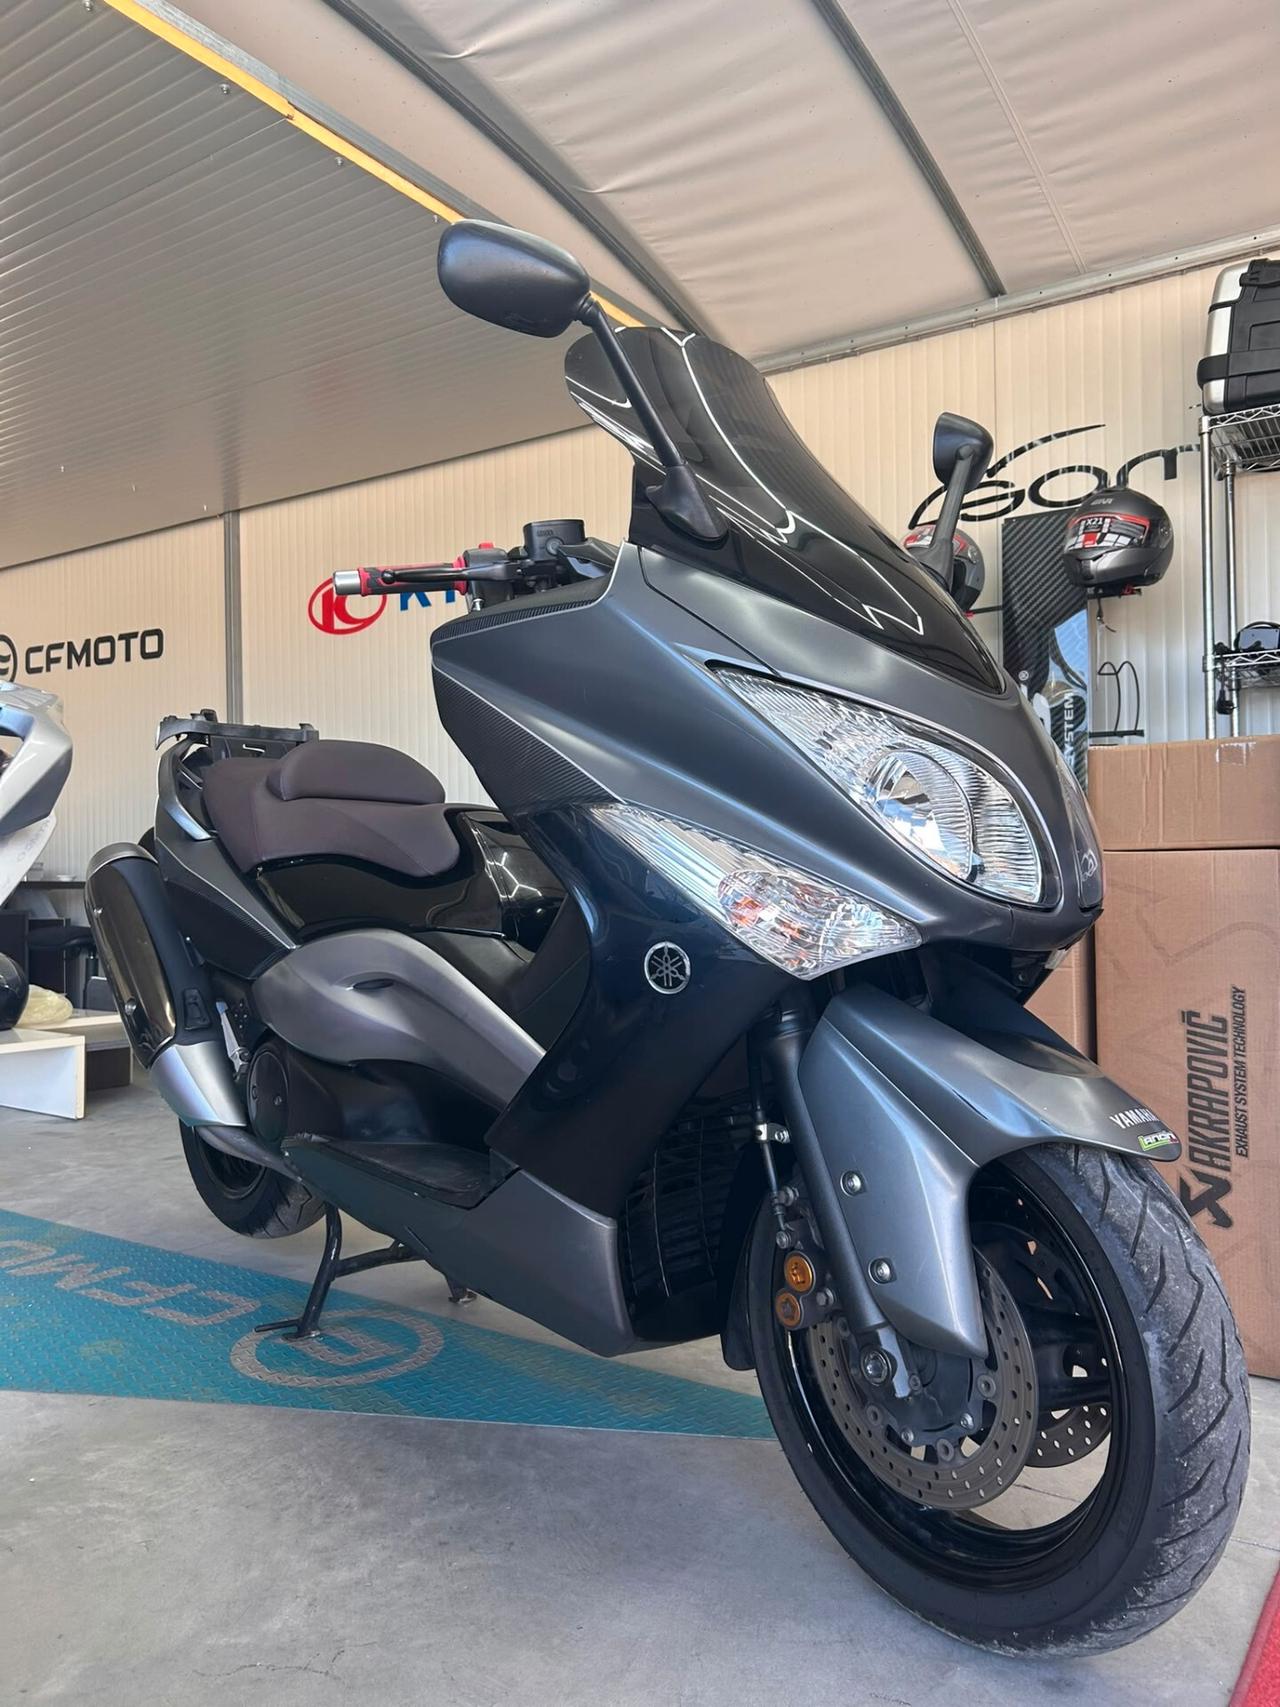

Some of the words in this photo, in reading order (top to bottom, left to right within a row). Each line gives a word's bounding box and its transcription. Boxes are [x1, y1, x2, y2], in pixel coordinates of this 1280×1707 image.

[25, 628, 164, 675] CFMOTO
[1231, 986, 1246, 1059] TECHNOLOGY
[1233, 1059, 1248, 1106] SYSTEM
[1235, 1106, 1249, 1158] EXHAUST
